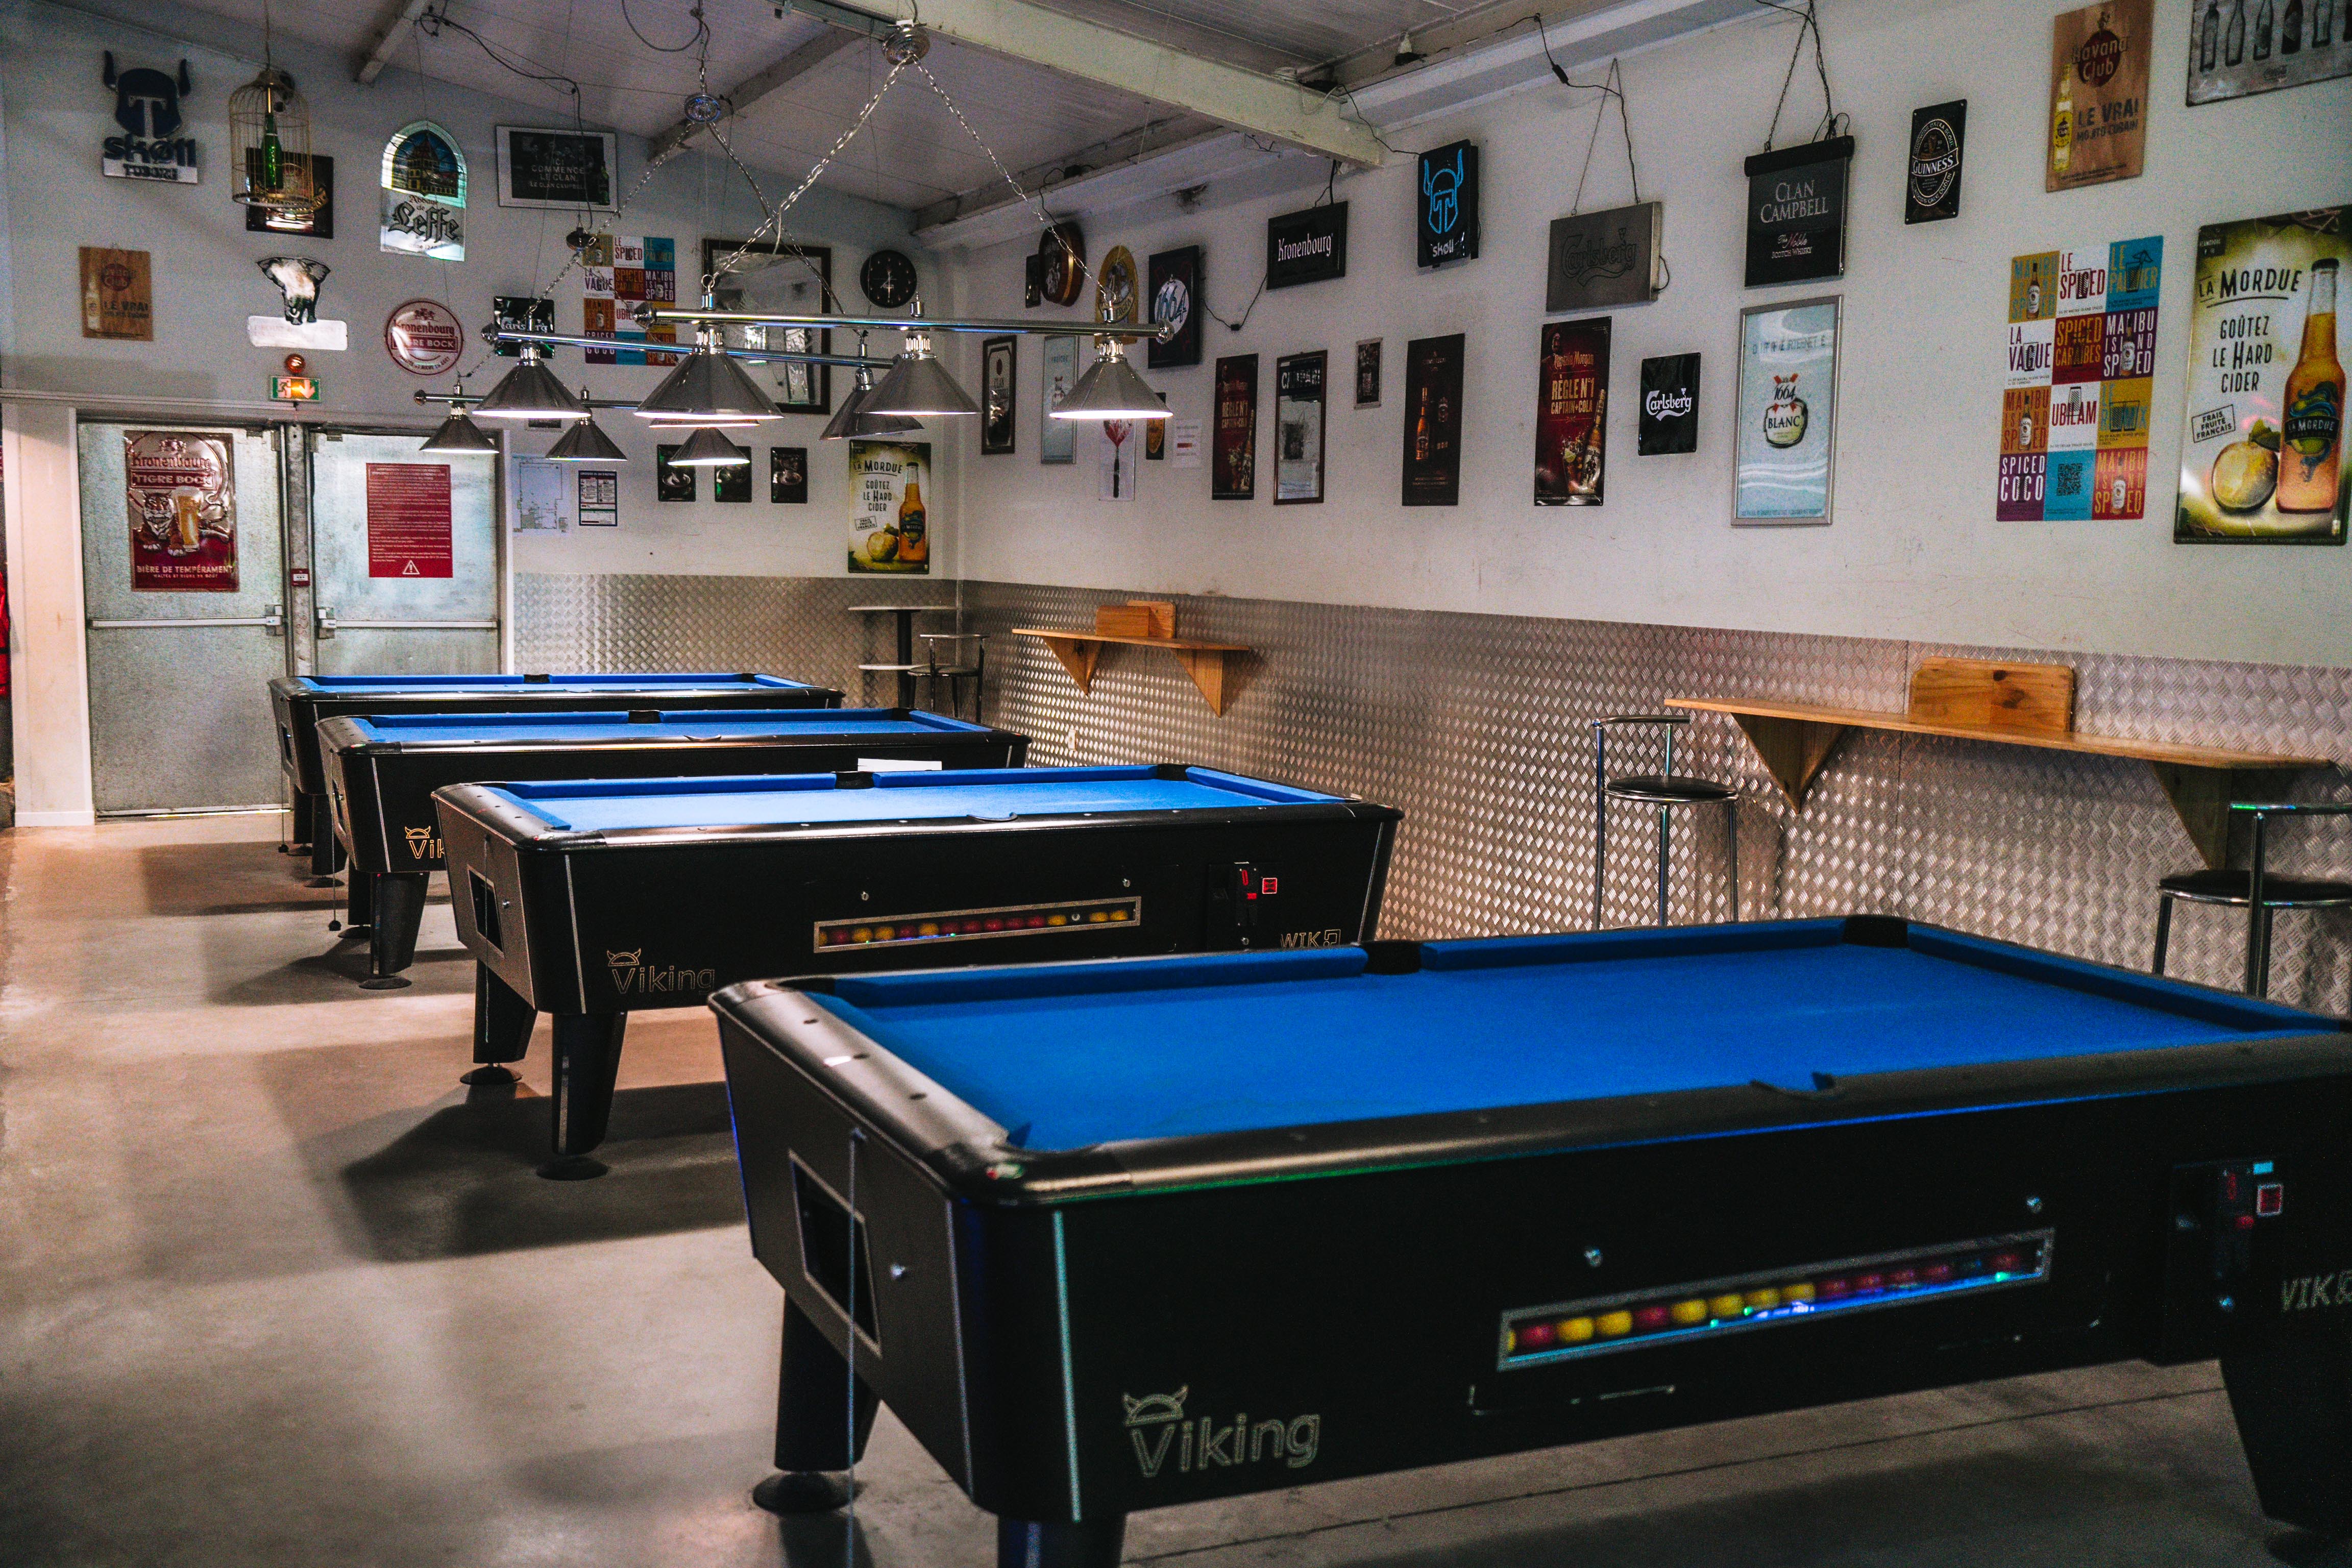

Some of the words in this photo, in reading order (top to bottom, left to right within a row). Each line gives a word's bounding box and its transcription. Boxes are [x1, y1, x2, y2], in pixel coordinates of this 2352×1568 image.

[2083, 57, 2114, 81] Club
[2078, 107, 2095, 126] LE
[2101, 97, 2139, 122] VRAI
[1913, 155, 1953, 175] GUINNESS
[1775, 179, 1815, 202] CLAN
[387, 201, 459, 243] Leffe
[1760, 197, 1829, 224] CAMPBELL
[615, 237, 622, 247] LE
[1278, 233, 1332, 262] Kronenbourg
[1782, 231, 1808, 249] Noble
[615, 247, 643, 260] SPICED
[1561, 231, 1637, 283] Carlsberg
[2061, 253, 2073, 273] LE
[2110, 244, 2127, 271] LE
[645, 270, 673, 281] MAIBU
[2059, 268, 2106, 300] SPICED
[2198, 281, 2214, 298] LA
[2220, 268, 2302, 299] MORDUE
[646, 288, 674, 300] SPED
[1156, 285, 1187, 324] 1664
[2010, 326, 2022, 345] LA
[2056, 316, 2103, 347] SPICED
[2220, 314, 2270, 339] GOÛTEZ
[427, 339, 454, 348] BOCK
[2213, 347, 2226, 368] LE
[2233, 340, 2272, 370] HARD
[2008, 342, 2052, 372] VAGUE
[2103, 351, 2152, 377] SPED
[1551, 374, 1579, 401] RÈGLE
[1580, 377, 1595, 399] N°1
[1774, 385, 1797, 401] 1664
[2221, 371, 2260, 394] CIDER
[1646, 388, 1693, 420] Carlsberg
[2005, 389, 2050, 411] MAIBU
[1768, 415, 1800, 429] BLANC
[2051, 400, 2097, 427] UBILAM
[2202, 411, 2223, 424] FRAIS
[131, 453, 211, 472] Kronenbourg
[864, 460, 903, 474] MORDUE
[2001, 455, 2046, 475] SPICED
[2096, 450, 2145, 473] MAIBU
[135, 475, 174, 483] TIGRE
[176, 476, 213, 485] BOCK
[866, 479, 890, 490] GOÛTEZ
[2000, 475, 2044, 502] COCO
[863, 492, 870, 501] LE
[873, 490, 892, 502] HARD
[868, 503, 887, 511] CIDER
[2094, 489, 2142, 514] SPED
[136, 564, 160, 573] BIÈRE
[175, 564, 233, 574] TEMPÉRAMENT
[408, 839, 445, 859] Vik
[612, 965, 715, 995] Viking
[1130, 1412, 1321, 1479] Viking
